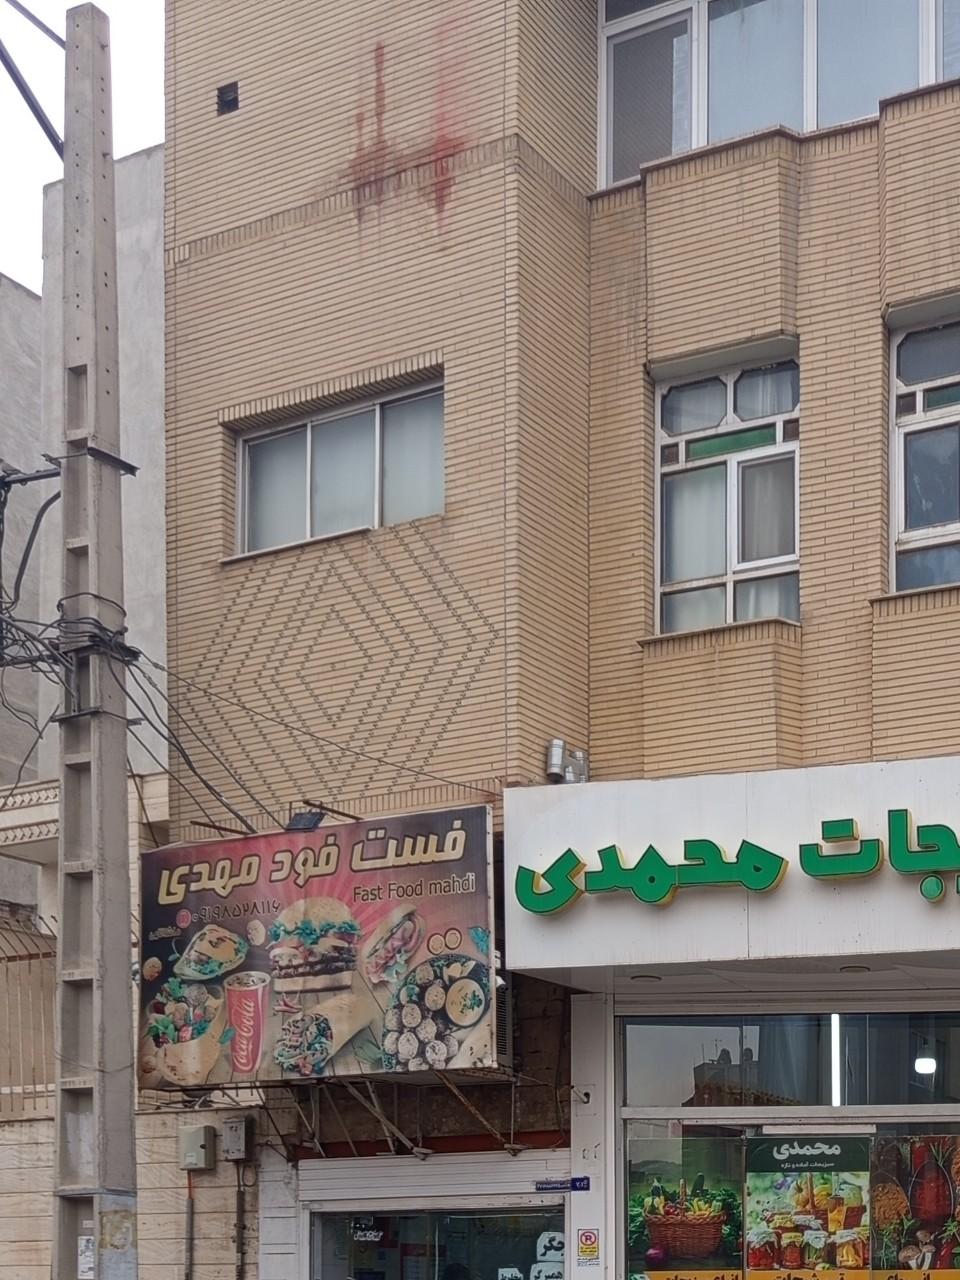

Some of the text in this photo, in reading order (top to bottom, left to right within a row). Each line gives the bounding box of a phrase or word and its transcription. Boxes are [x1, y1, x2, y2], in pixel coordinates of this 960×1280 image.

[158, 819, 467, 905] فست فود مهدی
[515, 838, 790, 916] محمدی
[353, 873, 476, 903] Fast Food mahdi
[773, 1141, 841, 1160] محمدی
[541, 1235, 565, 1256] جگر
